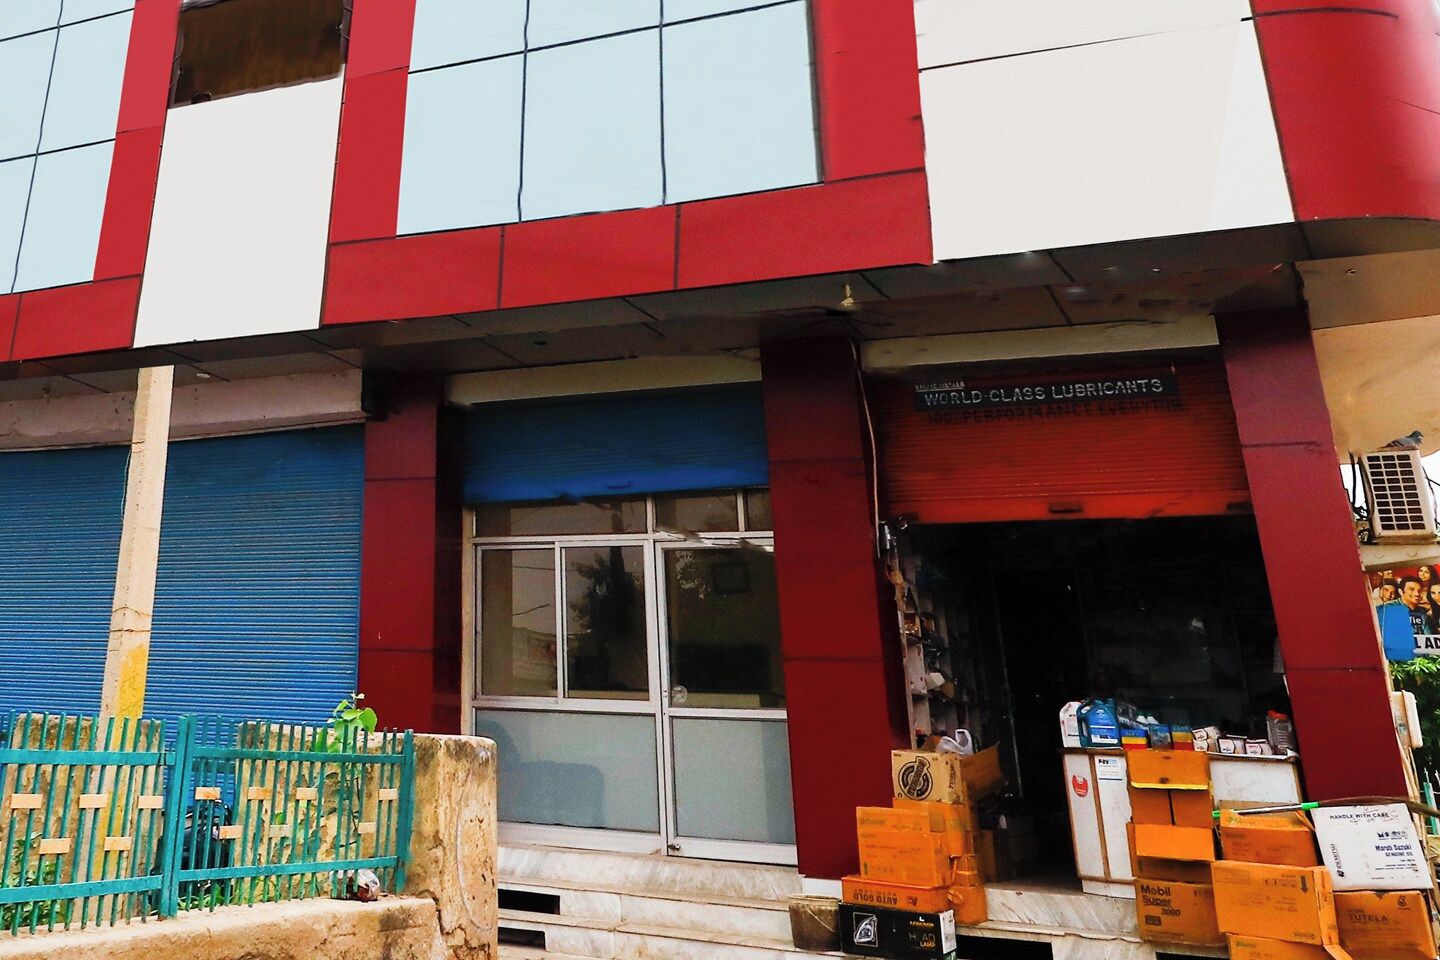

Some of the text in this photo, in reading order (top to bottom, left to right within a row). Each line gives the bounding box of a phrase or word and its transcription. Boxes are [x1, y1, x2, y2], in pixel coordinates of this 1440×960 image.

[1051, 378, 1164, 399] LUBRICANTS
[1140, 884, 1171, 897] Mobil
[1142, 895, 1171, 907] Super
